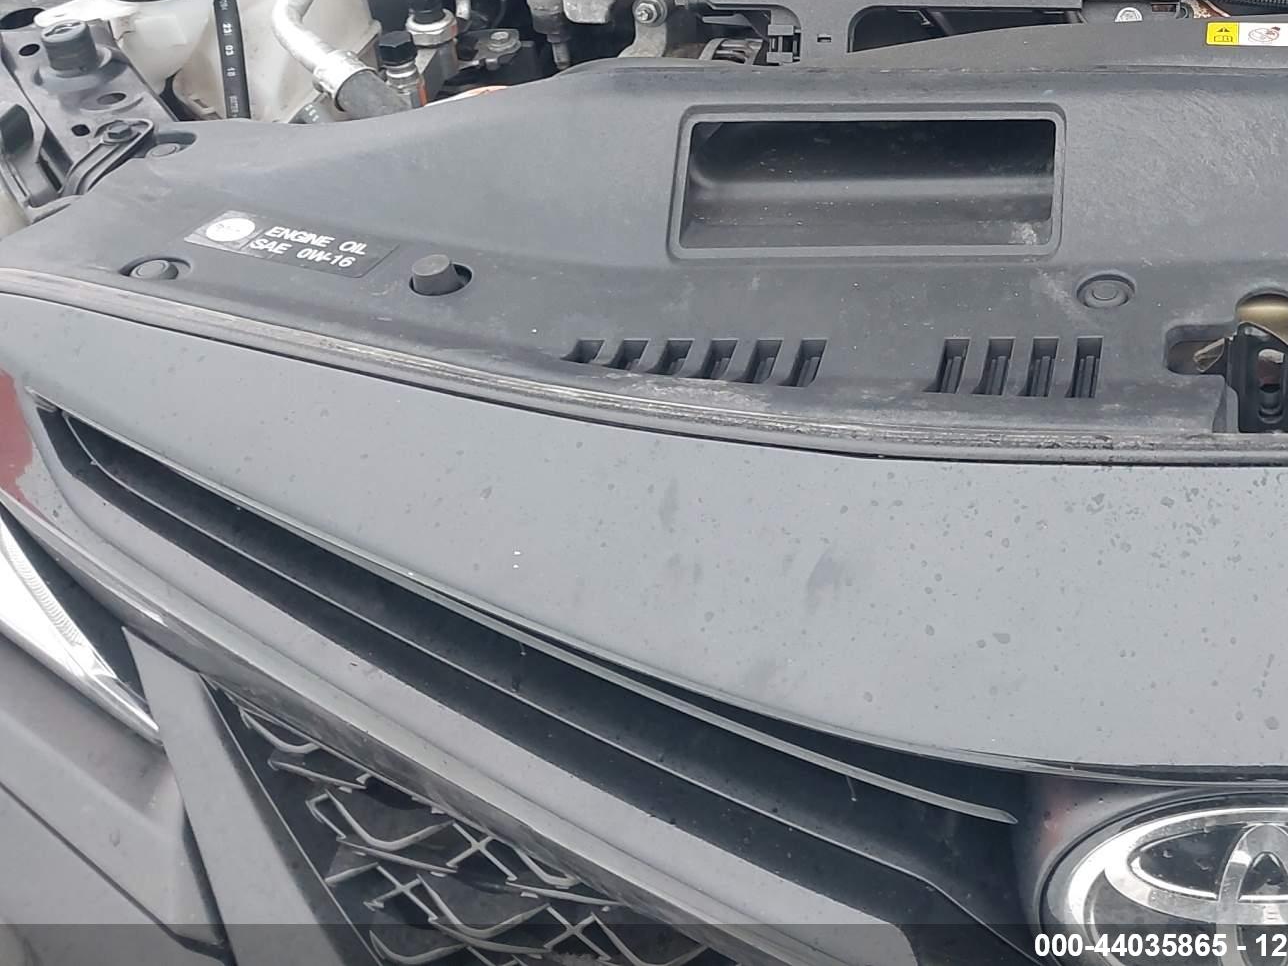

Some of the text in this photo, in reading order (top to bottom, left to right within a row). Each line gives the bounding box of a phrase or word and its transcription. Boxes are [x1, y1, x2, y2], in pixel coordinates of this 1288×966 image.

[250, 238, 356, 267] SAE 0W-16
[265, 226, 335, 248] ENGINE
[339, 241, 368, 255] OIL
